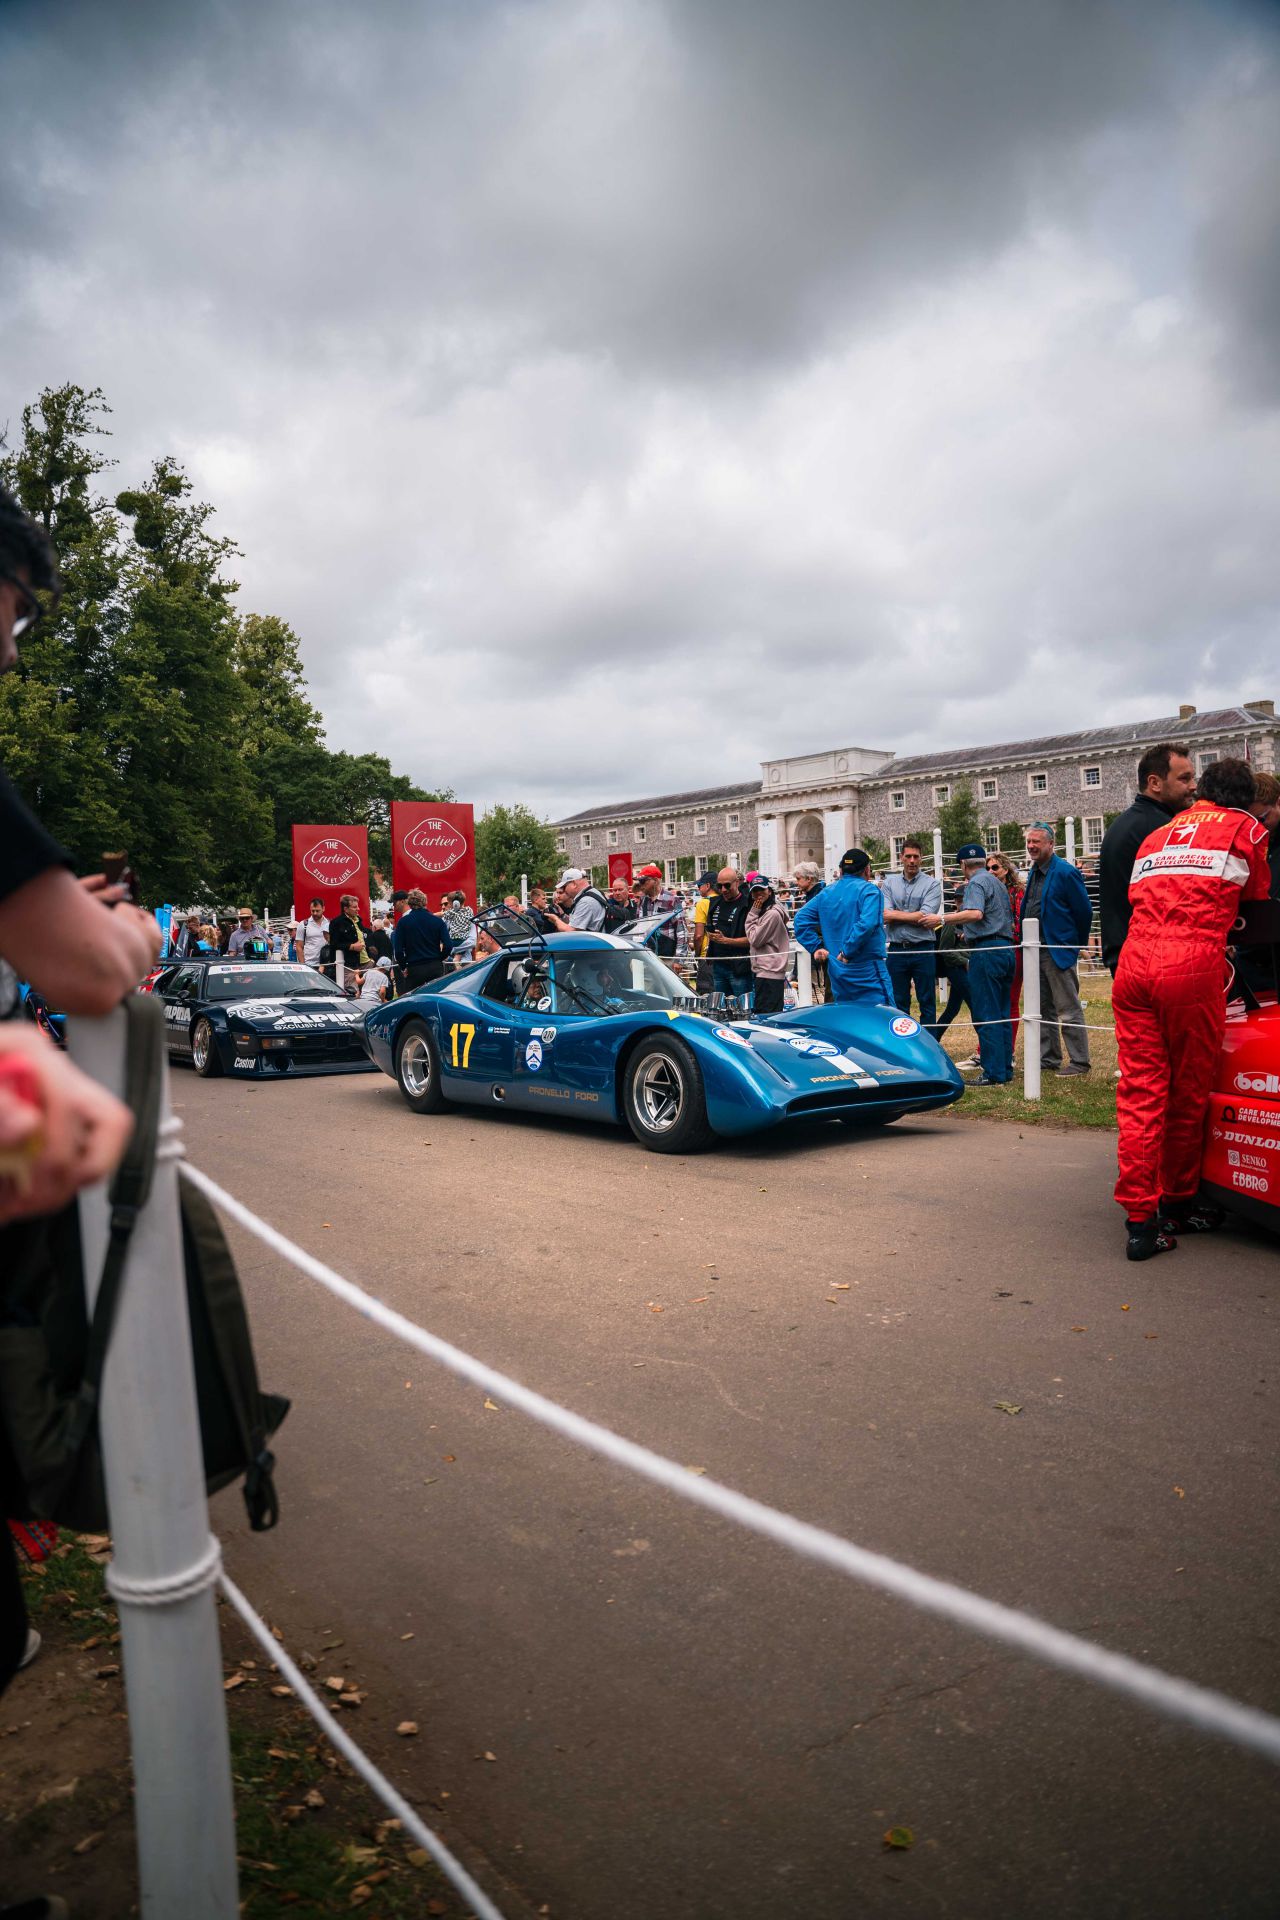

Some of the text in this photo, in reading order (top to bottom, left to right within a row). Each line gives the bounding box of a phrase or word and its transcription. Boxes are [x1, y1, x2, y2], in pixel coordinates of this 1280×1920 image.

[428, 821, 442, 830] THE
[325, 841, 339, 849] THE
[412, 831, 458, 846] Cartier
[311, 850, 353, 864] Cartier
[415, 852, 432, 869] STYLE
[443, 852, 457, 867] LUXE
[313, 868, 329, 883] STYLE
[339, 868, 352, 882] LUXE
[274, 1022, 326, 1030] exclusive
[449, 1023, 476, 1068] 17
[234, 1056, 256, 1069] Castrol
[810, 1069, 906, 1083] PRONELLO FORD
[1237, 1072, 1280, 1093] boll
[528, 1086, 599, 1102] PRONELLO FORD
[1239, 1107, 1258, 1117] CARE
[1241, 1153, 1267, 1168] SENKO
[1232, 1171, 1268, 1192] EBBRO
